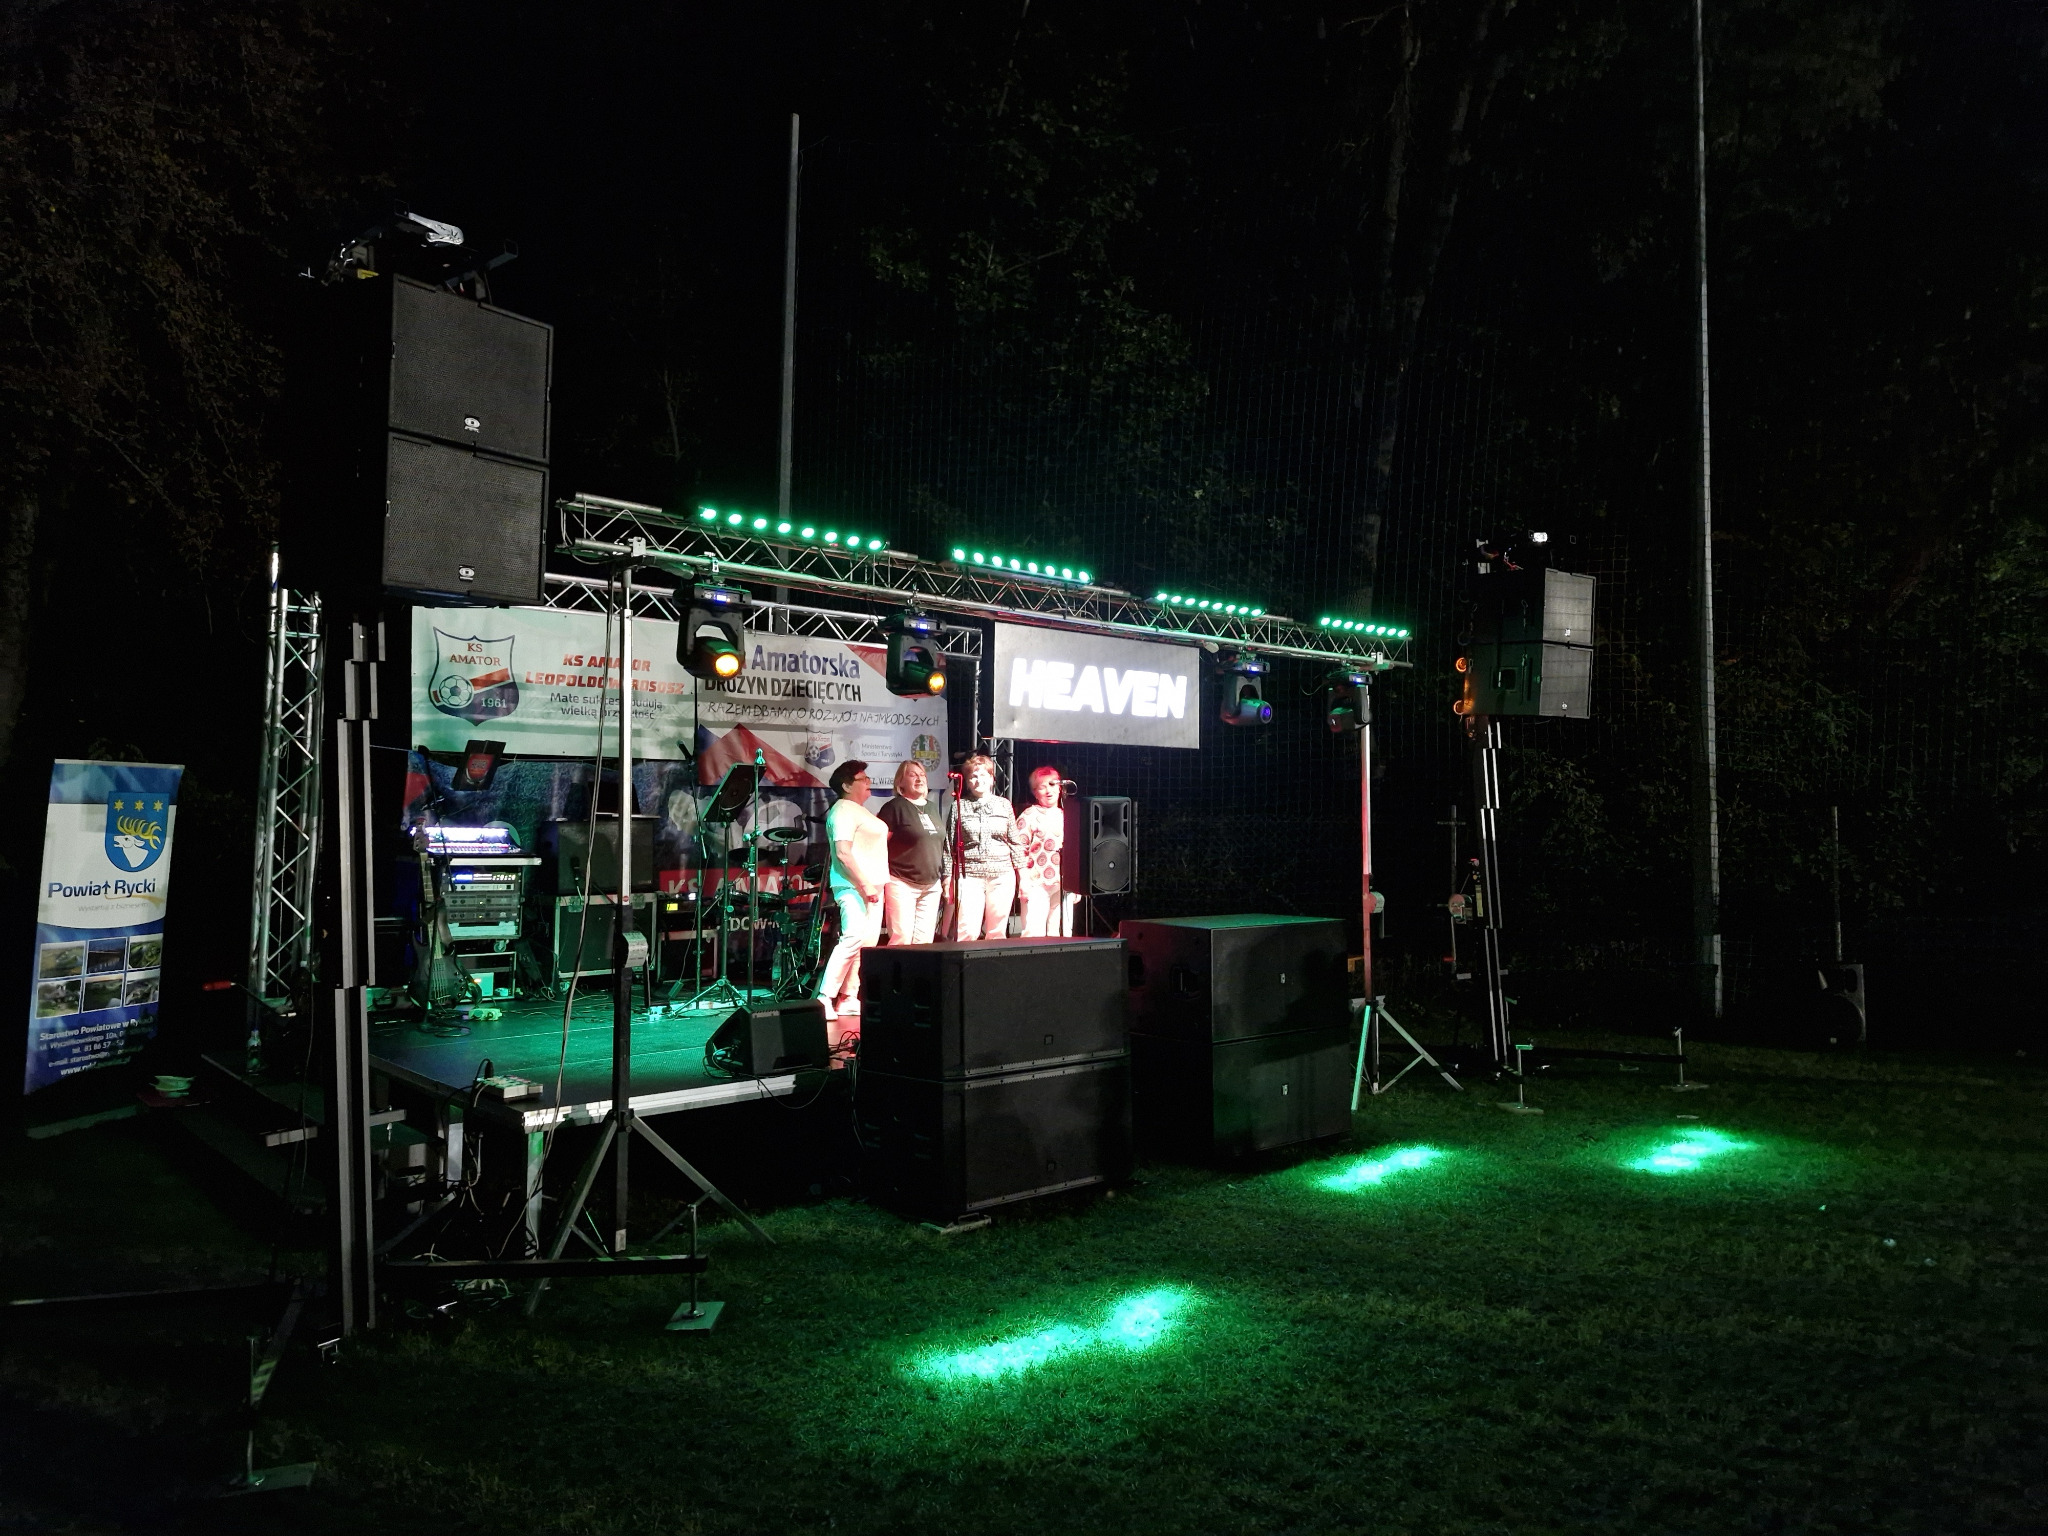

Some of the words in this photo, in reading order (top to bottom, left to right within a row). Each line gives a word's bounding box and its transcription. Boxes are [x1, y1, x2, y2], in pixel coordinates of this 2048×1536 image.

[467, 642, 483, 653] KS
[449, 653, 502, 667] AMATOR
[562, 654, 584, 667] KS
[587, 653, 652, 673] AMAOR
[751, 644, 861, 680] Amatorska
[771, 677, 863, 705] DZIECIĘCYCH
[1009, 657, 1188, 720] HEAVEN
[481, 697, 507, 709] 1961
[550, 692, 580, 704] Małe
[561, 704, 597, 719] wielką
[708, 701, 751, 716] RAZEM
[753, 704, 793, 719] DBAMY
[796, 707, 807, 719] O
[809, 707, 858, 723] ROZWÓJ
[860, 711, 940, 726] NAJMŁODSZYCH
[861, 743, 893, 751] Ministerstwo
[114, 878, 156, 898] Rycki
[80, 1022, 121, 1035] Powiatowe
